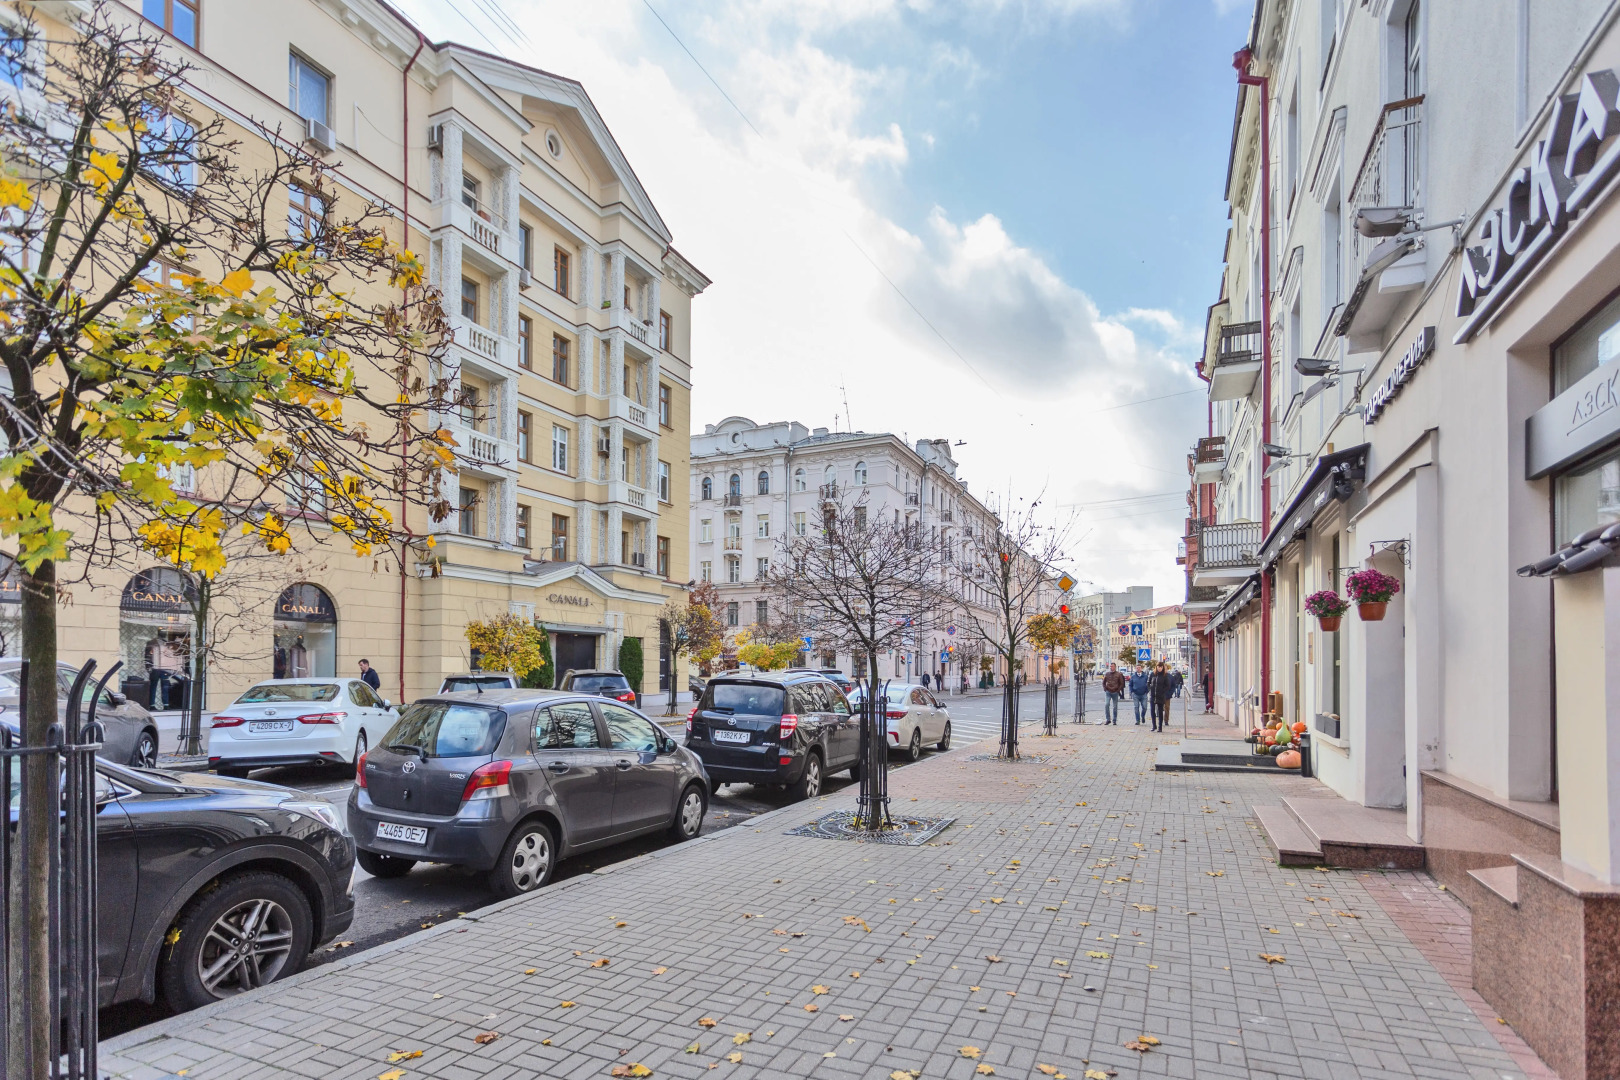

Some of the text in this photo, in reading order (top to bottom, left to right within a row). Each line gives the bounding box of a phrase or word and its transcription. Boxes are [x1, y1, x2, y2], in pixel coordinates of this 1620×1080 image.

[1454, 70, 1620, 318] ЛЭСКА
[132, 591, 187, 604] CANAL
[548, 593, 589, 607] CANALI
[281, 604, 326, 615] CANALI
